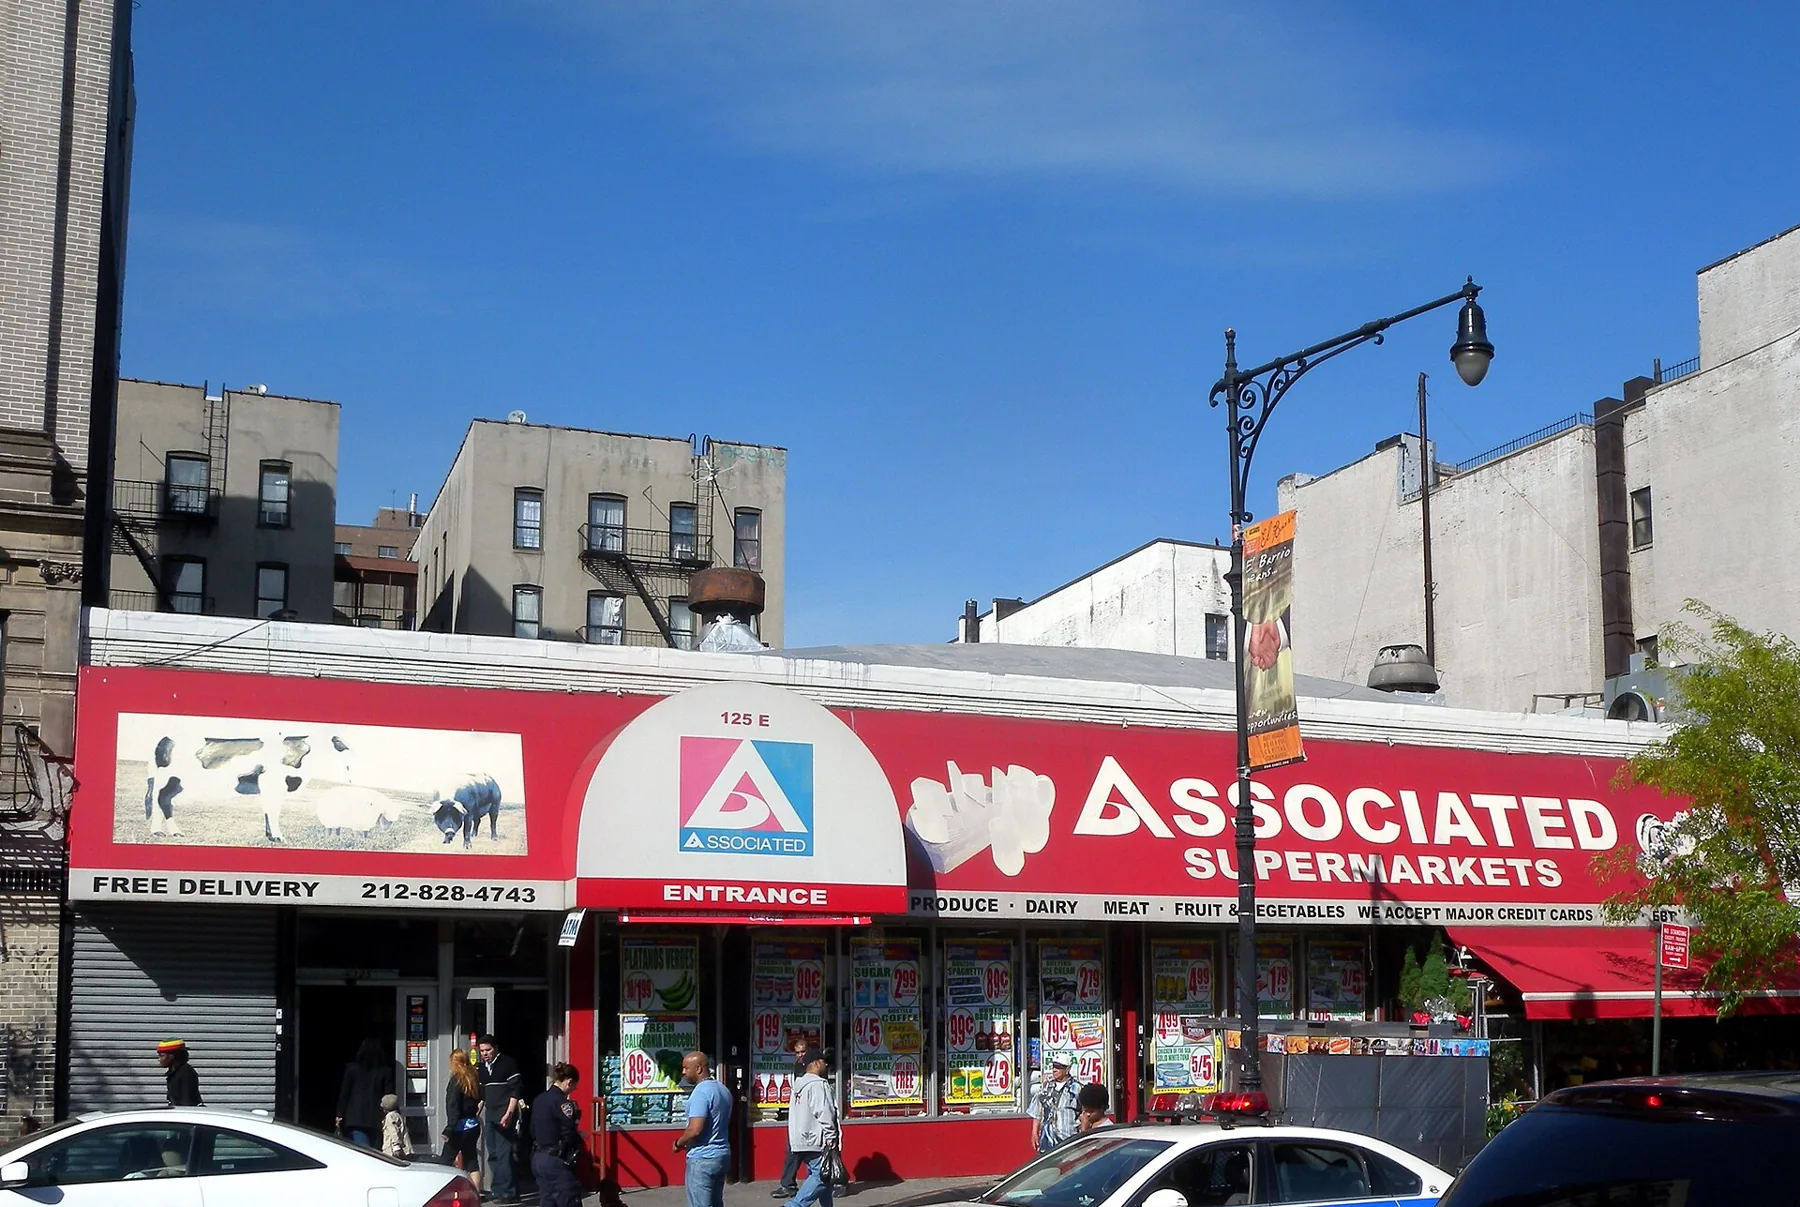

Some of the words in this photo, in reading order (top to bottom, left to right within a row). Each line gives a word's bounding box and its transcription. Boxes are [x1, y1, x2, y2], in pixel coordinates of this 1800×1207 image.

[1259, 546, 1290, 568] Barrio
[721, 712, 752, 725] 125
[758, 714, 770, 727] E
[1073, 755, 1618, 850] ASSOCIATED
[684, 832, 805, 852] ASSOCIATED
[1183, 848, 1563, 887] SUPERMARKETS
[93, 877, 168, 893] FREE
[179, 879, 320, 897] DELIVERY
[361, 883, 536, 902] 212-828-4743
[663, 885, 828, 905] ENTRANCE
[911, 897, 998, 912] PRODUCE
[1026, 900, 1078, 914] DAIRY
[1104, 901, 1150, 915] MEAT
[1175, 903, 1222, 916] FRUIT
[1256, 905, 1345, 918] EGETABLES
[1358, 906, 1381, 919] WE
[1385, 907, 1441, 919] ACCEPT
[1446, 908, 1493, 920] MAJOR
[1498, 908, 1546, 920] CREDIT
[1551, 909, 1593, 921] CARDS
[561, 919, 579, 935] ATM
[797, 967, 820, 999] 99¢
[854, 967, 891, 978] SUGAR
[948, 967, 983, 976] SPAGHETTI
[986, 968, 1009, 999] 89¢
[644, 1023, 675, 1032] FRESH
[882, 1014, 919, 1022] COFFEE
[1046, 1015, 1067, 1043] 79¢
[625, 1033, 662, 1048] CALIFORNIA
[664, 1033, 695, 1048] BROCCOLI
[950, 1015, 974, 1045] 99¢
[629, 1054, 651, 1084] 89¢
[856, 1062, 871, 1070] LOAF
[873, 1062, 891, 1070] CAKE
[950, 1060, 984, 1068] COFFEE
[987, 1060, 1010, 1089] 2/3
[1080, 1058, 1101, 1084] 2/5
[1192, 1055, 1211, 1080] 5/5
